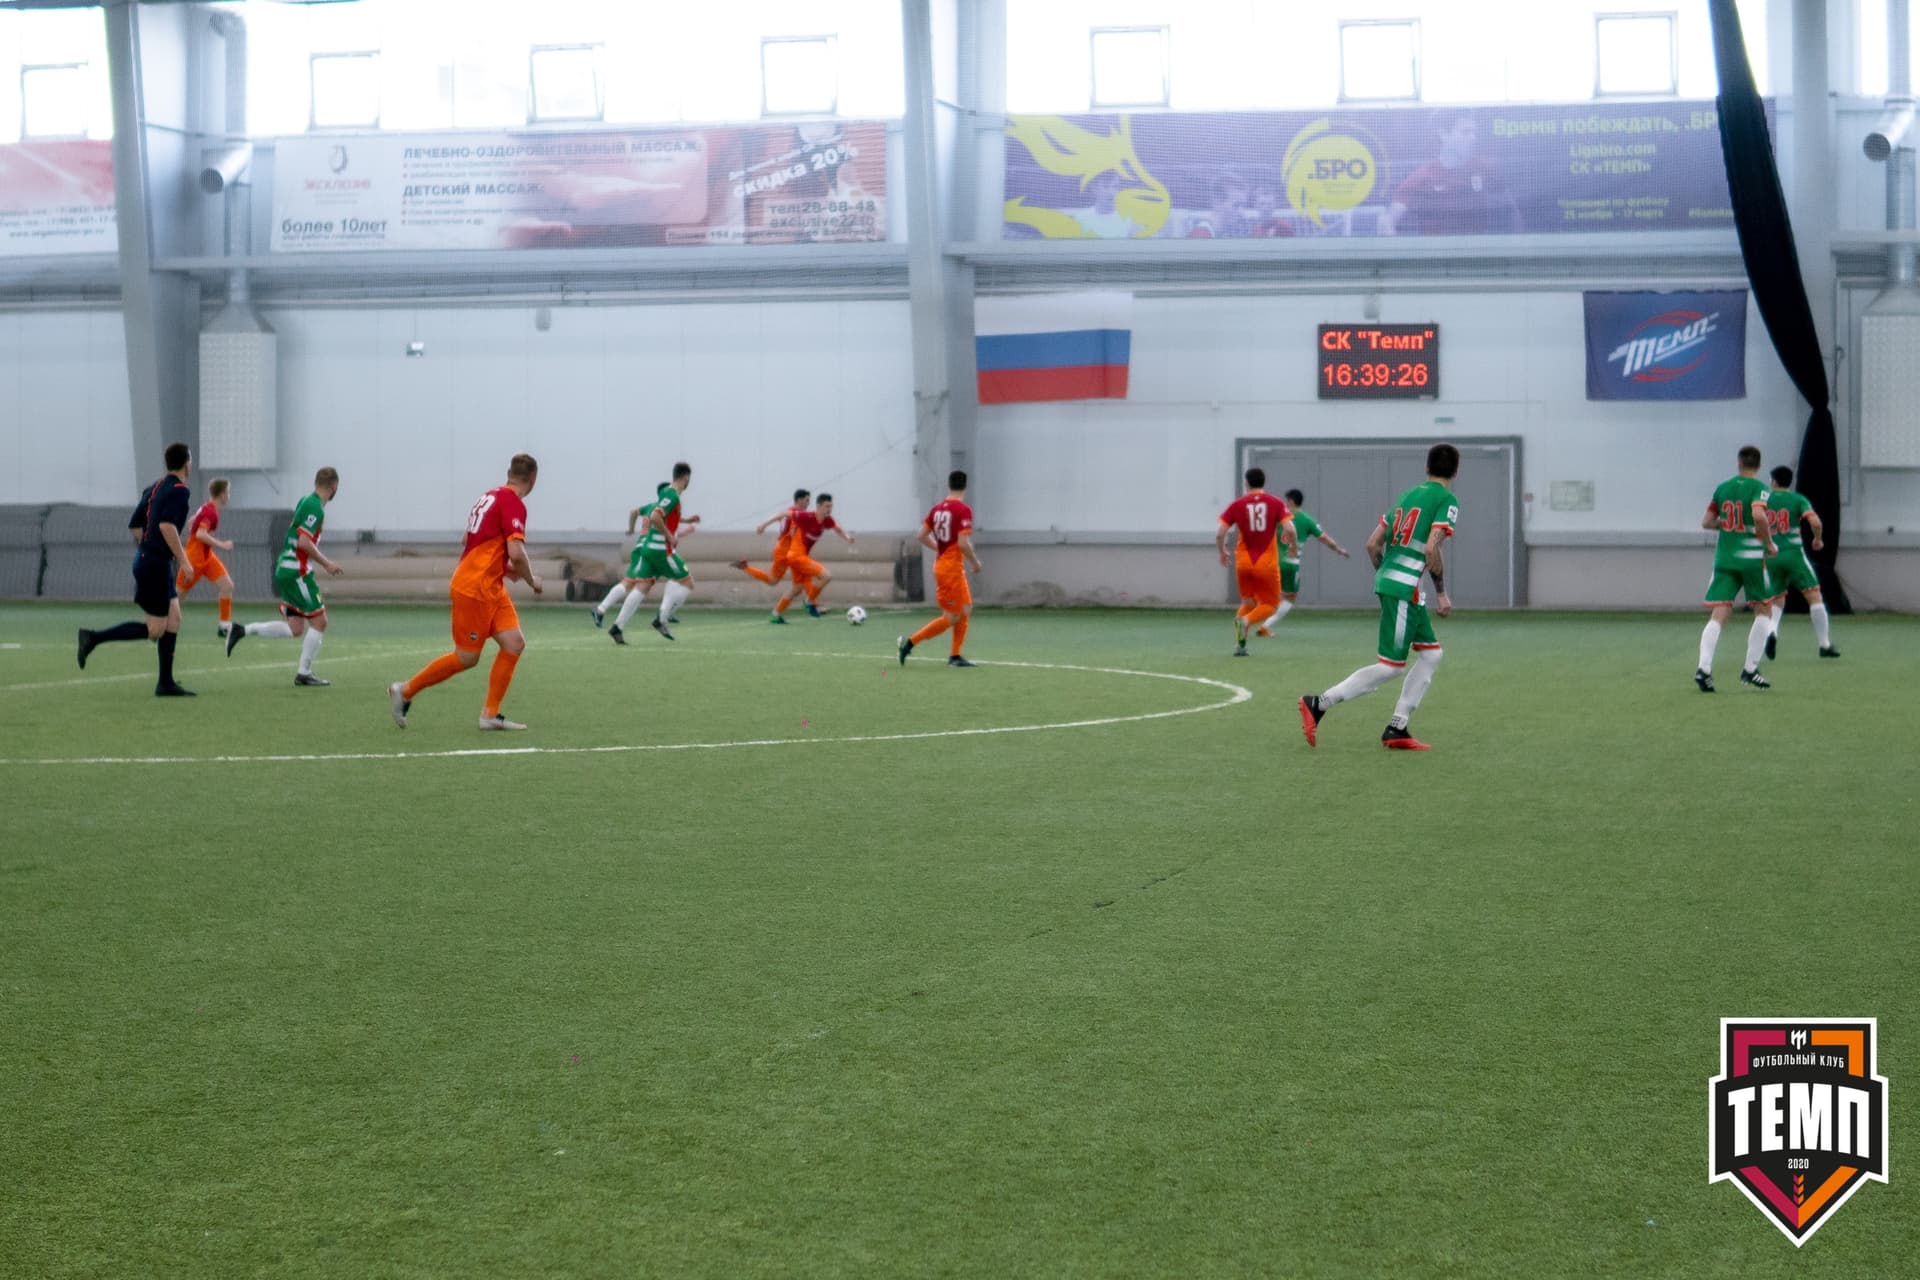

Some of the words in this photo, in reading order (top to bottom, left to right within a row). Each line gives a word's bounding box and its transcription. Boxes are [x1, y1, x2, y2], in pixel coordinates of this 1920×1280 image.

[1494, 118, 1557, 138] Время
[1562, 113, 1679, 135] побеждать,
[811, 142, 859, 172] 20%
[1307, 157, 1368, 181] .БРО
[402, 182, 470, 197] ДЕТСКИЙ
[281, 218, 335, 234] более
[1322, 330, 1352, 351] СК
[1357, 330, 1434, 351] "Темп"
[1323, 362, 1429, 386] 16:39:26
[1246, 502, 1267, 532] 13
[1721, 500, 1746, 532] 31
